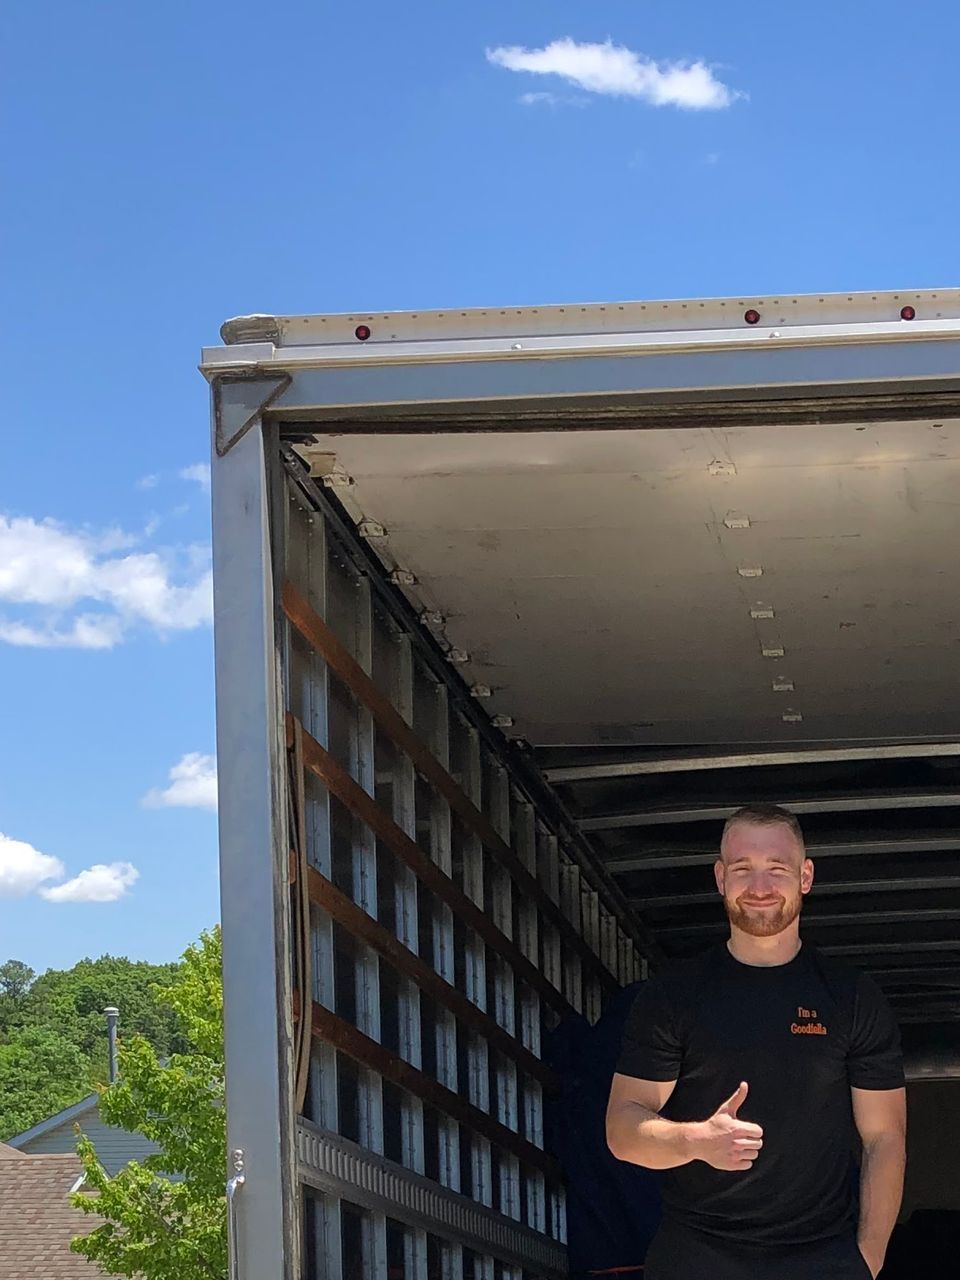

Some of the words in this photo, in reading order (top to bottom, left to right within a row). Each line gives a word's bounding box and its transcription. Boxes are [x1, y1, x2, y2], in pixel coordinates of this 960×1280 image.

[798, 1007, 810, 1018] I'm
[811, 1010, 817, 1018] a
[790, 1023, 827, 1035] Goodfella
